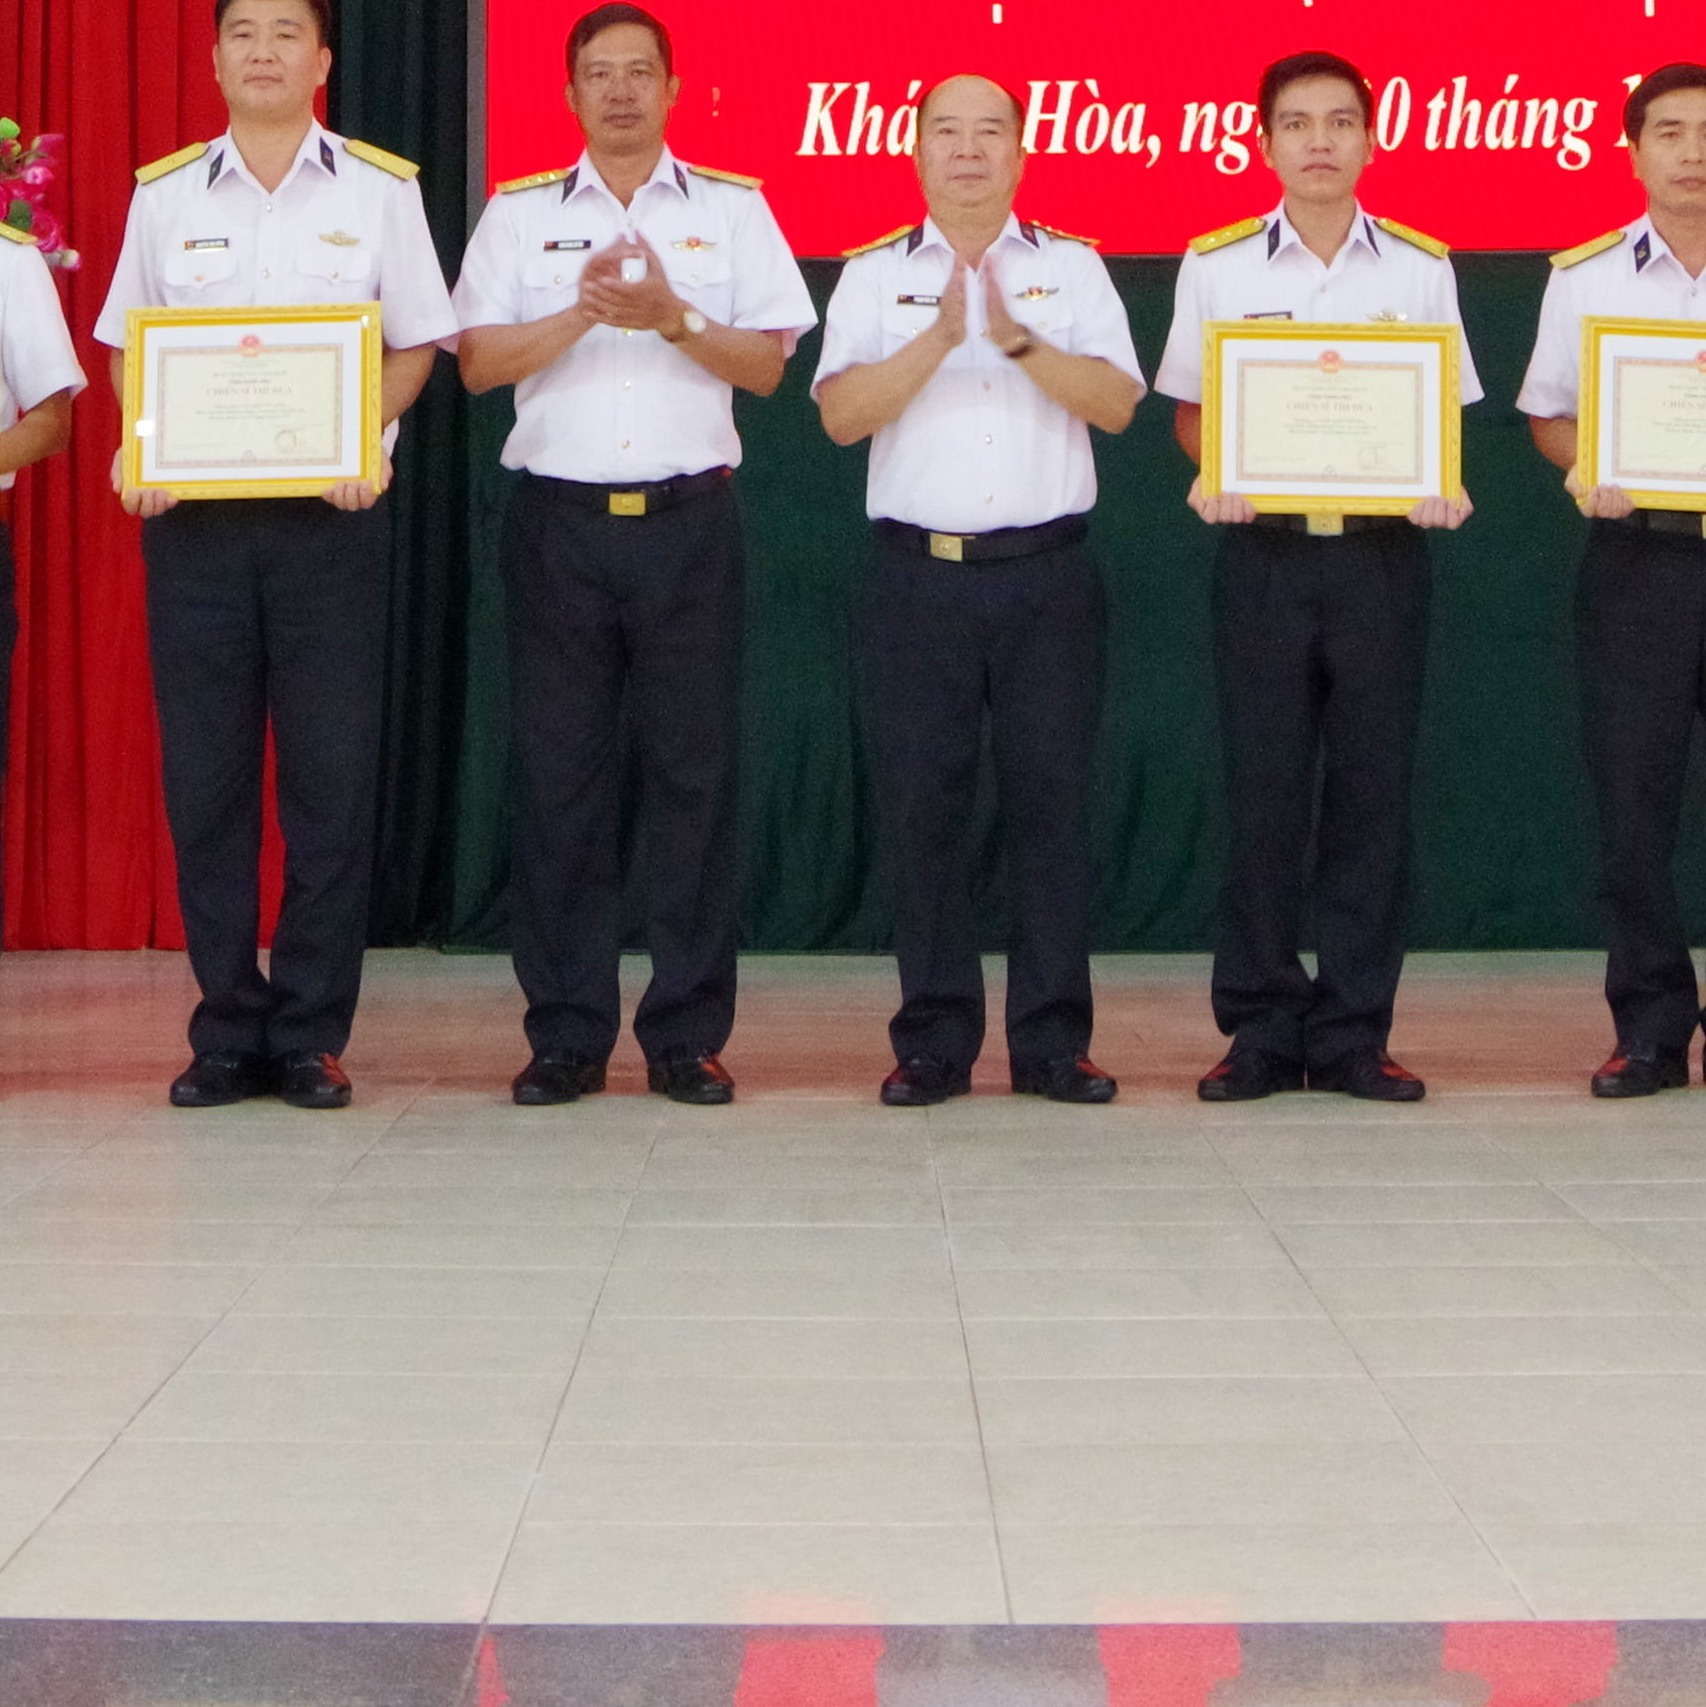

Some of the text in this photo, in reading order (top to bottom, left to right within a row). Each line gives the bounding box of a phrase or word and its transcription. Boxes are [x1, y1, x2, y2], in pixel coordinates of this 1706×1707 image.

[794, 80, 920, 156] Khá
[1021, 80, 1161, 168] Hòa,
[1179, 100, 1263, 175] ng
[1424, 74, 1598, 171] tháng
